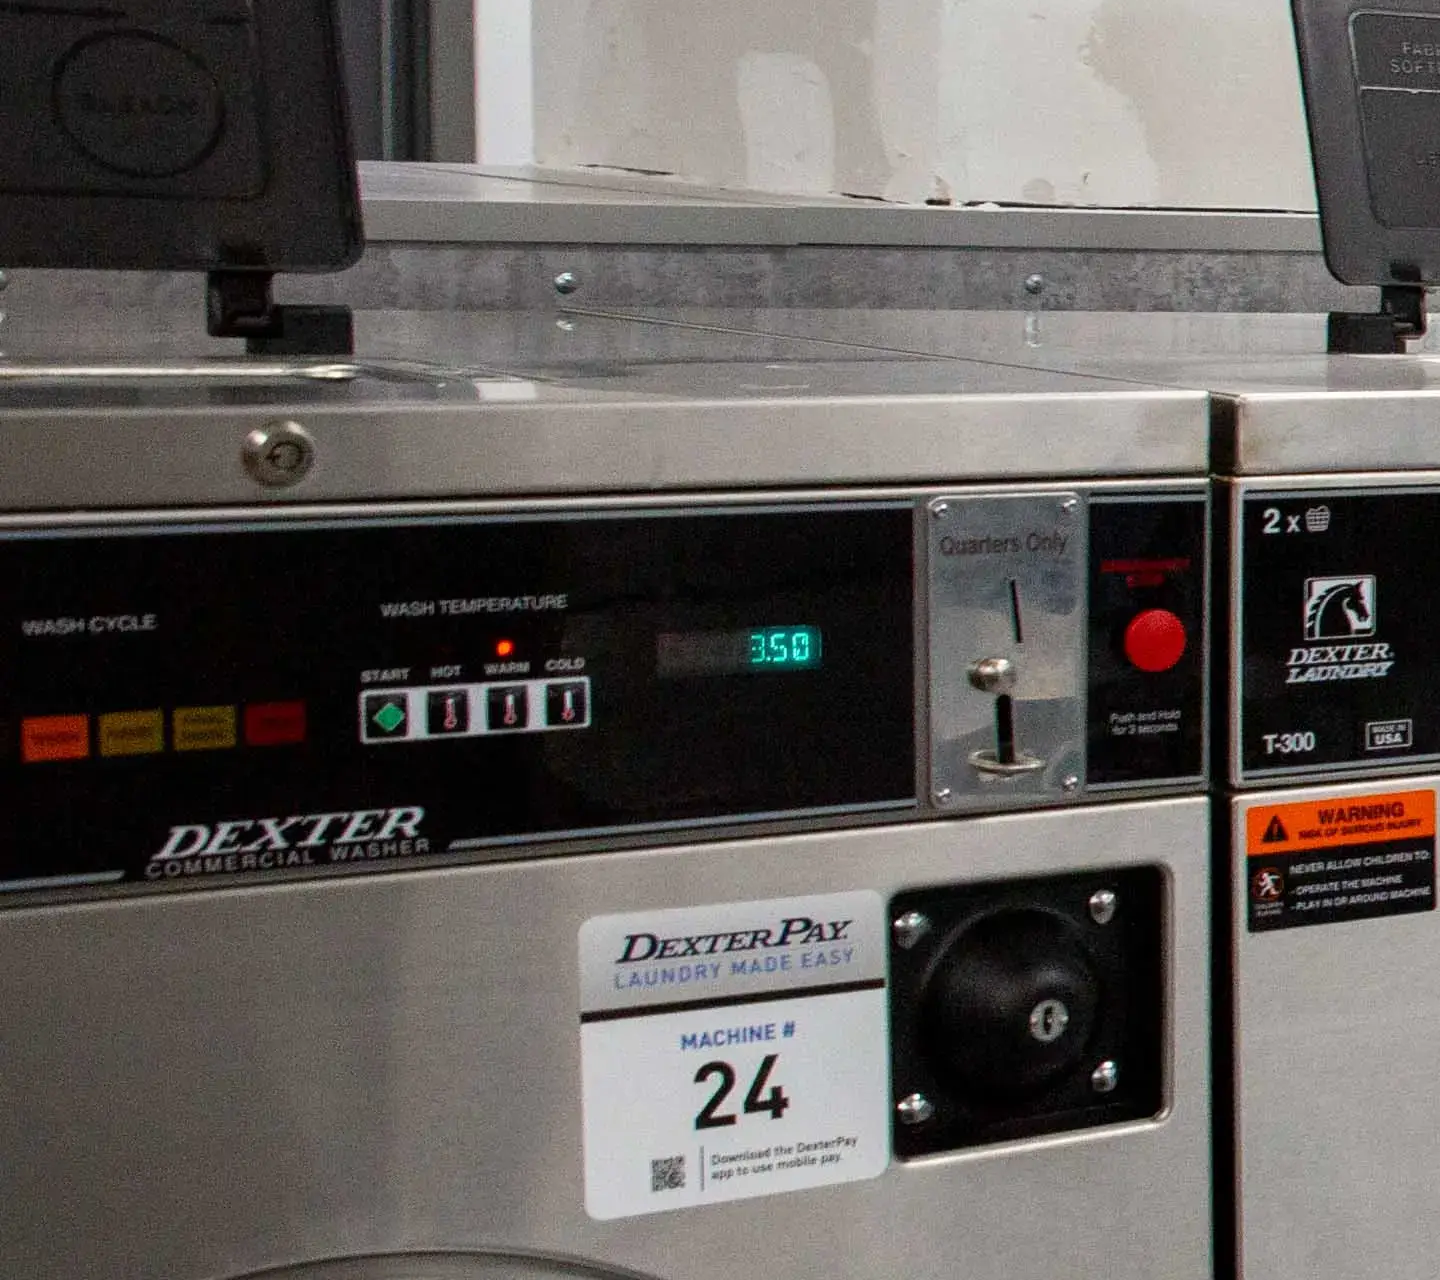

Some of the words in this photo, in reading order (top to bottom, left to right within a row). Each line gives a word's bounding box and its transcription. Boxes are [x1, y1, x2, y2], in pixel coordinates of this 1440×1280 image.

[1263, 509, 1281, 533] 2
[1287, 515, 1300, 533] x
[940, 536, 1019, 556] Quarters
[1026, 532, 1067, 555] Only
[381, 599, 435, 618] WASH
[440, 594, 568, 615] TEMPERATURE
[21, 619, 85, 637] WASH
[90, 615, 157, 633] CYCLE
[750, 631, 809, 663] 3.50
[1287, 643, 1391, 666] DEXTER
[361, 668, 409, 683] START
[431, 665, 461, 678] HOT
[484, 661, 530, 676] WARM
[546, 658, 585, 672] COLD
[1286, 661, 1395, 684] LAUNDRY
[1263, 731, 1315, 754] T-300
[1375, 732, 1402, 746] USA
[1318, 802, 1404, 824] WARNING
[152, 806, 425, 861] DEXTER
[145, 850, 314, 879] COMMERCIAL
[330, 838, 430, 862] WASHER
[1290, 862, 1325, 874] NEVER
[1326, 857, 1362, 871] ALLOW
[1363, 853, 1413, 867] CHILDREN
[1342, 879, 1359, 890] THE
[1361, 875, 1403, 887] MACHINE
[1323, 900, 1333, 908] IN
[1349, 892, 1388, 904] AROUND
[1390, 886, 1431, 899] MACHINE
[614, 962, 721, 991] LAUNDRY
[731, 954, 792, 976] MADE
[801, 948, 855, 969] EASY
[681, 1023, 777, 1051] MACHINE
[781, 1021, 796, 1038] #
[693, 1054, 790, 1130] 24
[712, 1148, 771, 1165] Download
[774, 1145, 793, 1156] the
[797, 1136, 858, 1152] DexterPay
[712, 1171, 733, 1180] app
[737, 1168, 749, 1176] to
[753, 1164, 773, 1173] use
[777, 1156, 817, 1169] mobile
